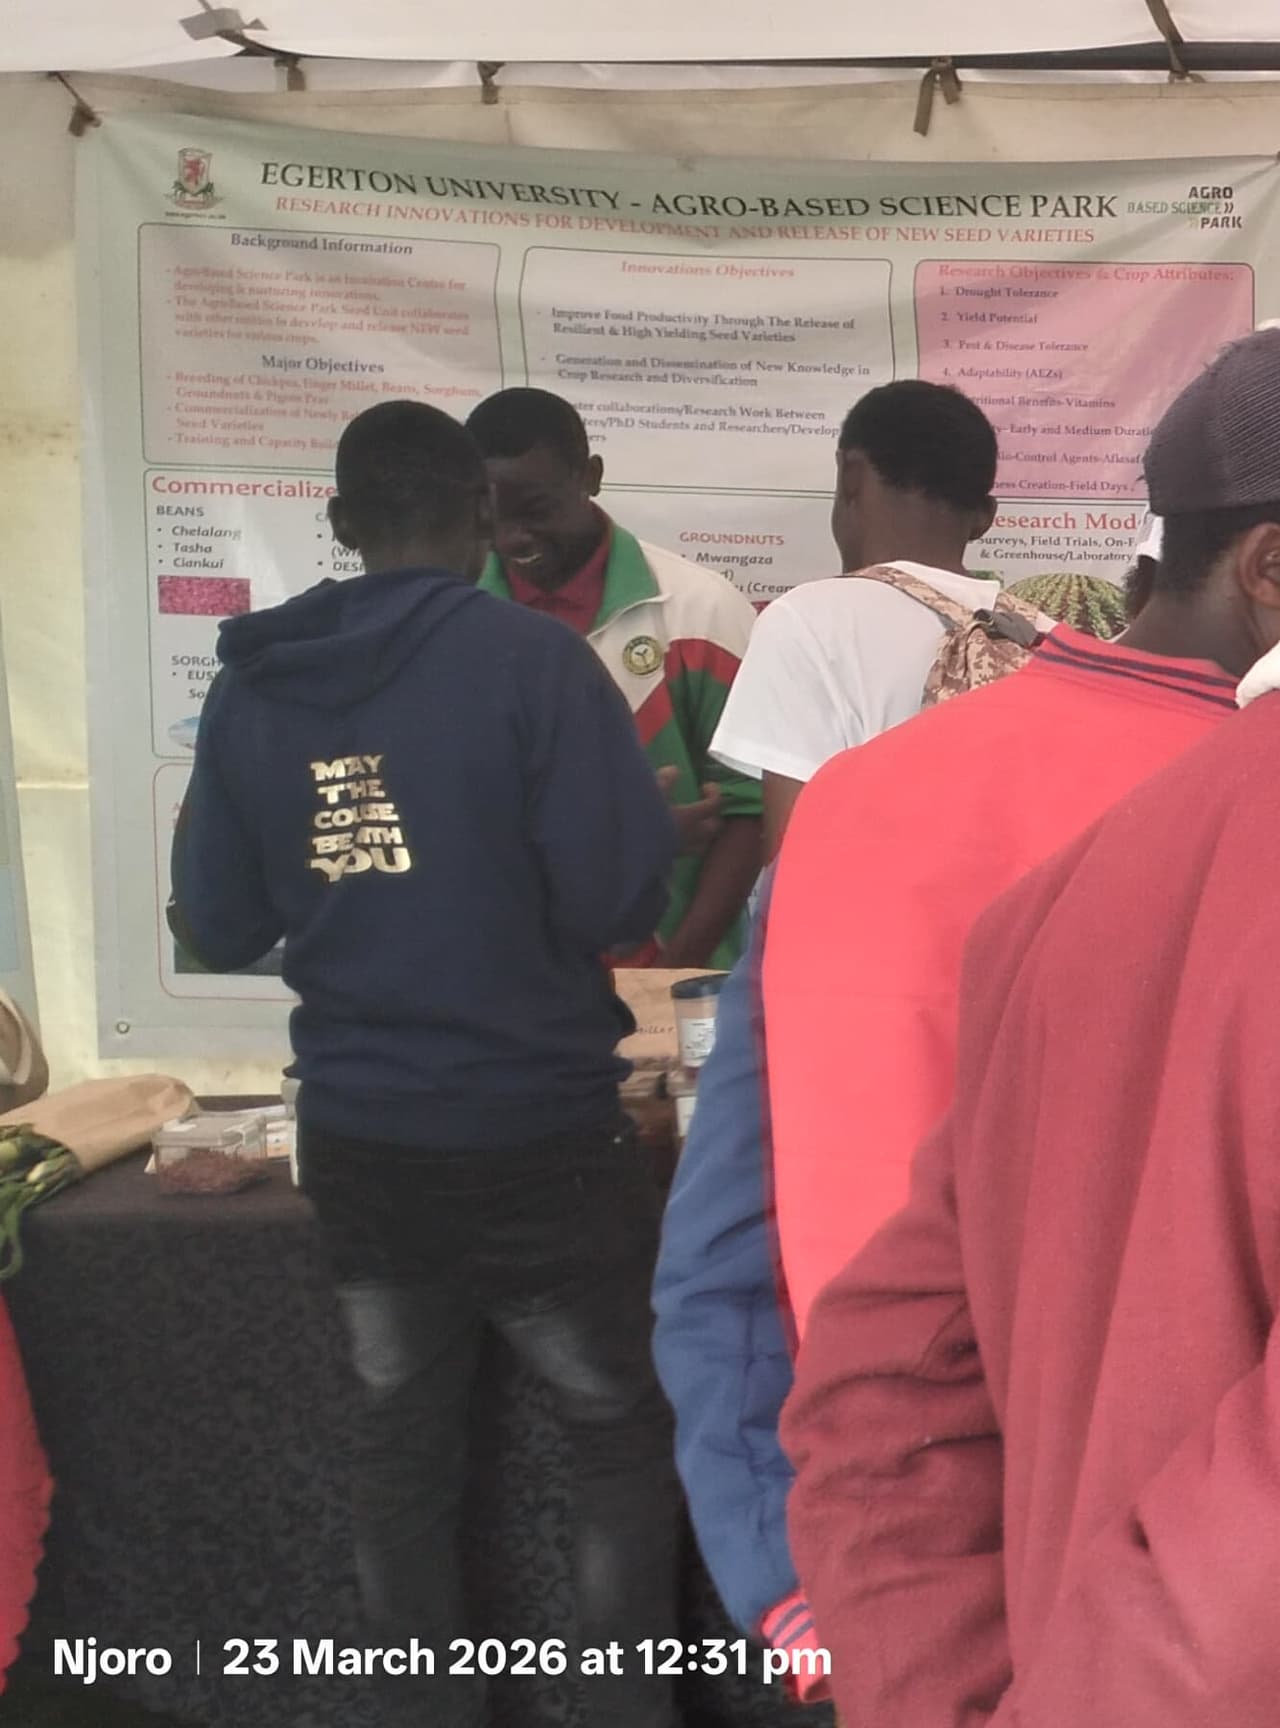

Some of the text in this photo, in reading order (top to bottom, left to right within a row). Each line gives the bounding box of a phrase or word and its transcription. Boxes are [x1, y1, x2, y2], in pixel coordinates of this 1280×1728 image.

[261, 162, 1118, 218] EGERTON UNIVERSITY AGRO-BASED SCIENCE PARK
[1188, 186, 1234, 200] AGRO
[1127, 201, 1222, 215] BASED SCIENCE
[275, 197, 1095, 243] RESEARCH INNOVATIONS FOR DEVELOPMENT AND RELEASE OF NEW SEED VARIETIES
[1200, 216, 1243, 229] PARK
[230, 233, 413, 255] Background Information
[621, 260, 795, 279] Innovations Objectives
[552, 307, 840, 330] Improve Food Productivity Through The Release
[261, 354, 385, 375] Major Objectives
[152, 476, 337, 499] Commercialize
[156, 505, 205, 518] BEANS
[171, 525, 242, 541] Chelalang
[679, 531, 785, 547] GROUNDNUTS
[173, 542, 213, 554] Tasha
[993, 548, 1134, 562] Greenhouse/Laboratory
[173, 557, 225, 569] Ciankui
[695, 551, 773, 567] Mwangaza
[310, 754, 384, 782] MAY
[318, 778, 386, 804] THE
[312, 832, 355, 854] BE
[310, 847, 411, 882] YOU
